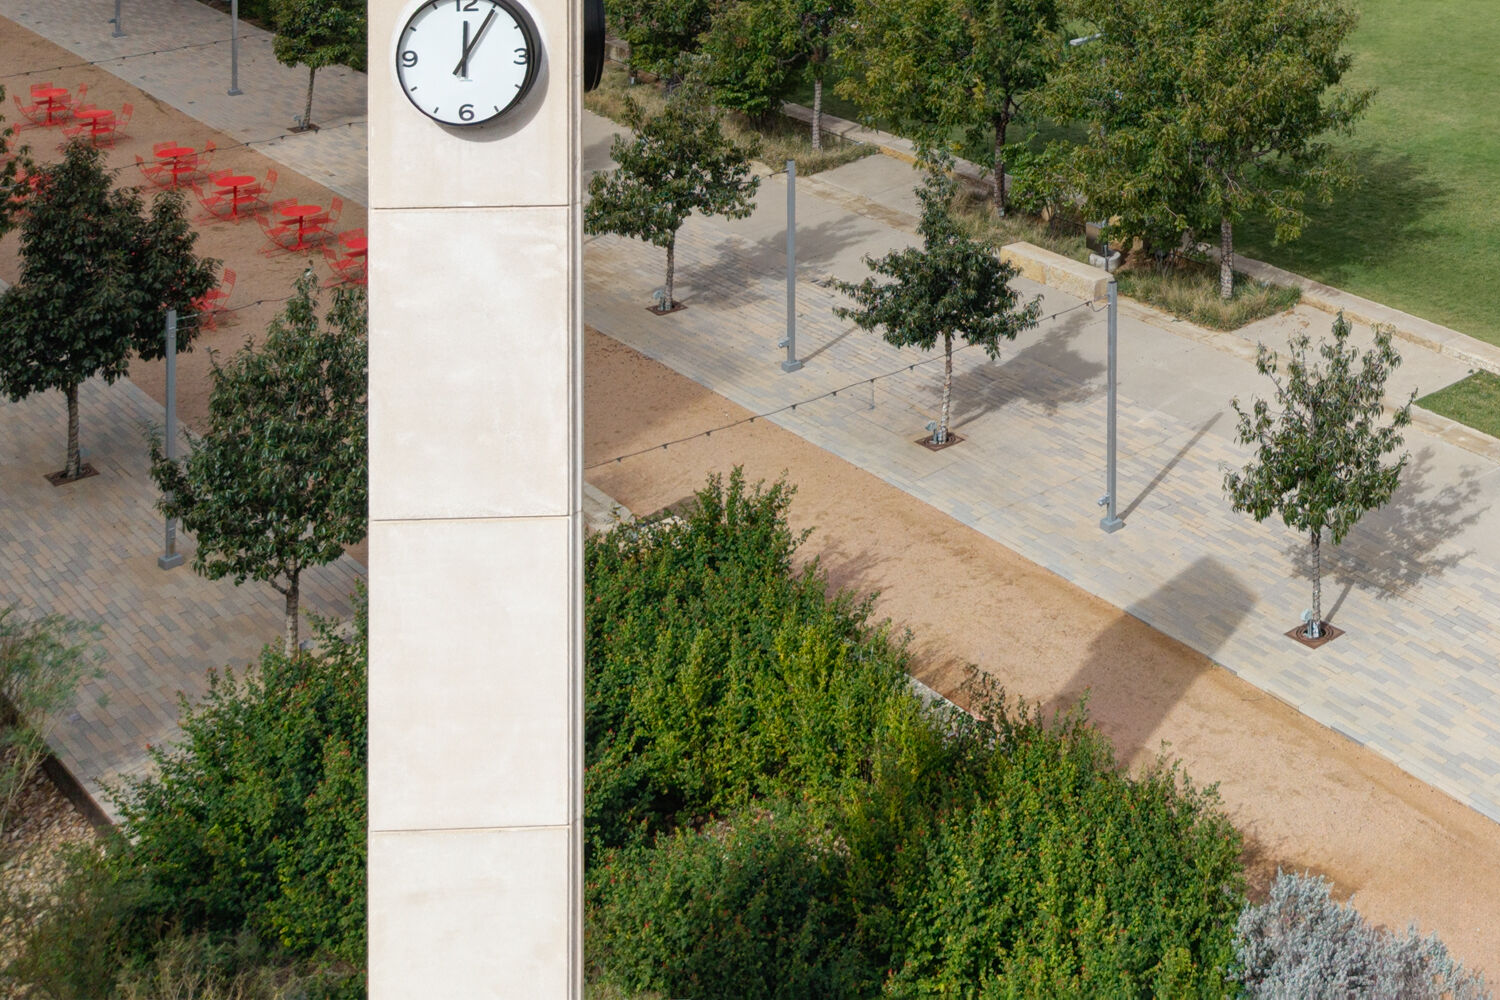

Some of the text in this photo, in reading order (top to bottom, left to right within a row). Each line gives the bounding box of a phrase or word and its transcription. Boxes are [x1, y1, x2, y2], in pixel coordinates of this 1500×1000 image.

[402, 50, 419, 68] 9
[513, 48, 528, 65] 3
[458, 104, 475, 121] 6
